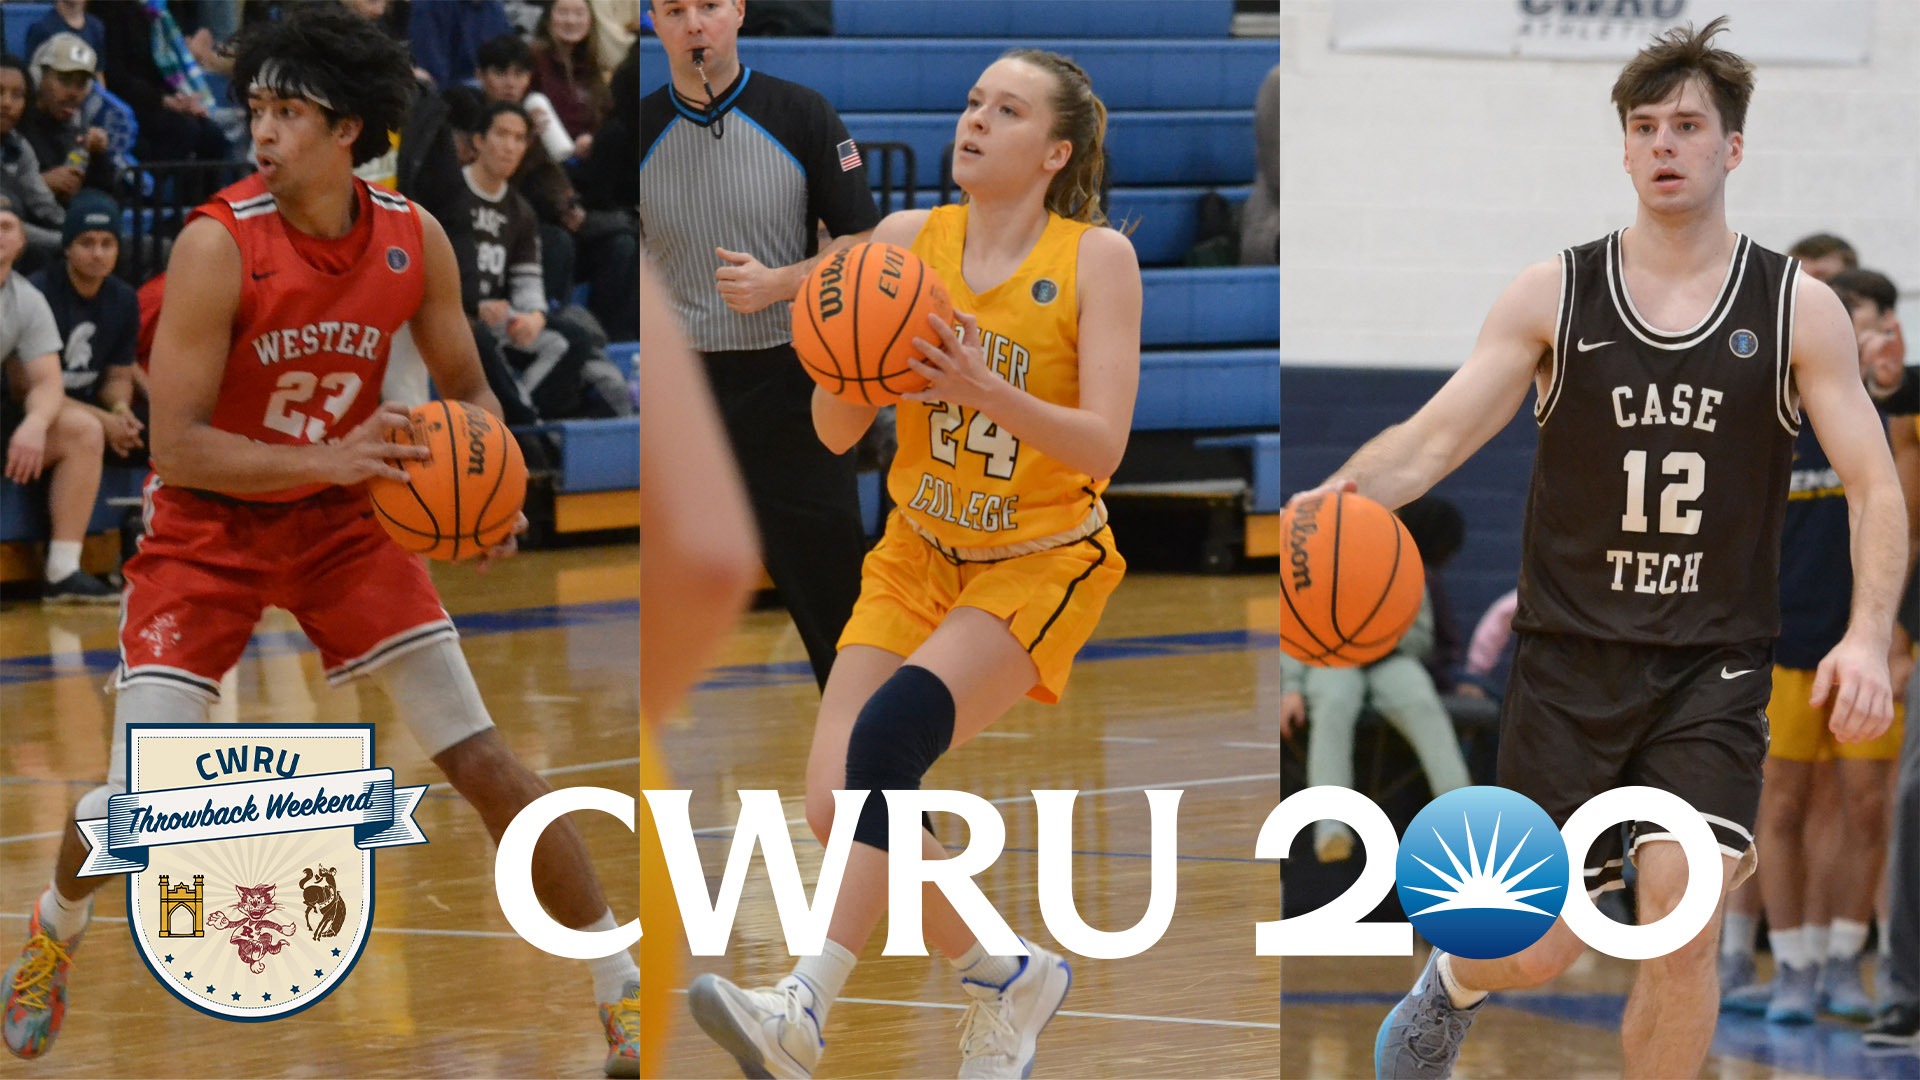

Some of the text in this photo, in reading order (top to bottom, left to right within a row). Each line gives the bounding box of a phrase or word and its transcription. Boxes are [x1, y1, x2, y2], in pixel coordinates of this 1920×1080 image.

[251, 320, 382, 367] WESTER
[262, 370, 364, 445] 23
[1611, 382, 1724, 433] CASE
[923, 399, 1021, 482] 24
[908, 471, 1020, 534] COLLEGE
[1621, 449, 1707, 536] 12
[1606, 549, 1704, 595] TECH
